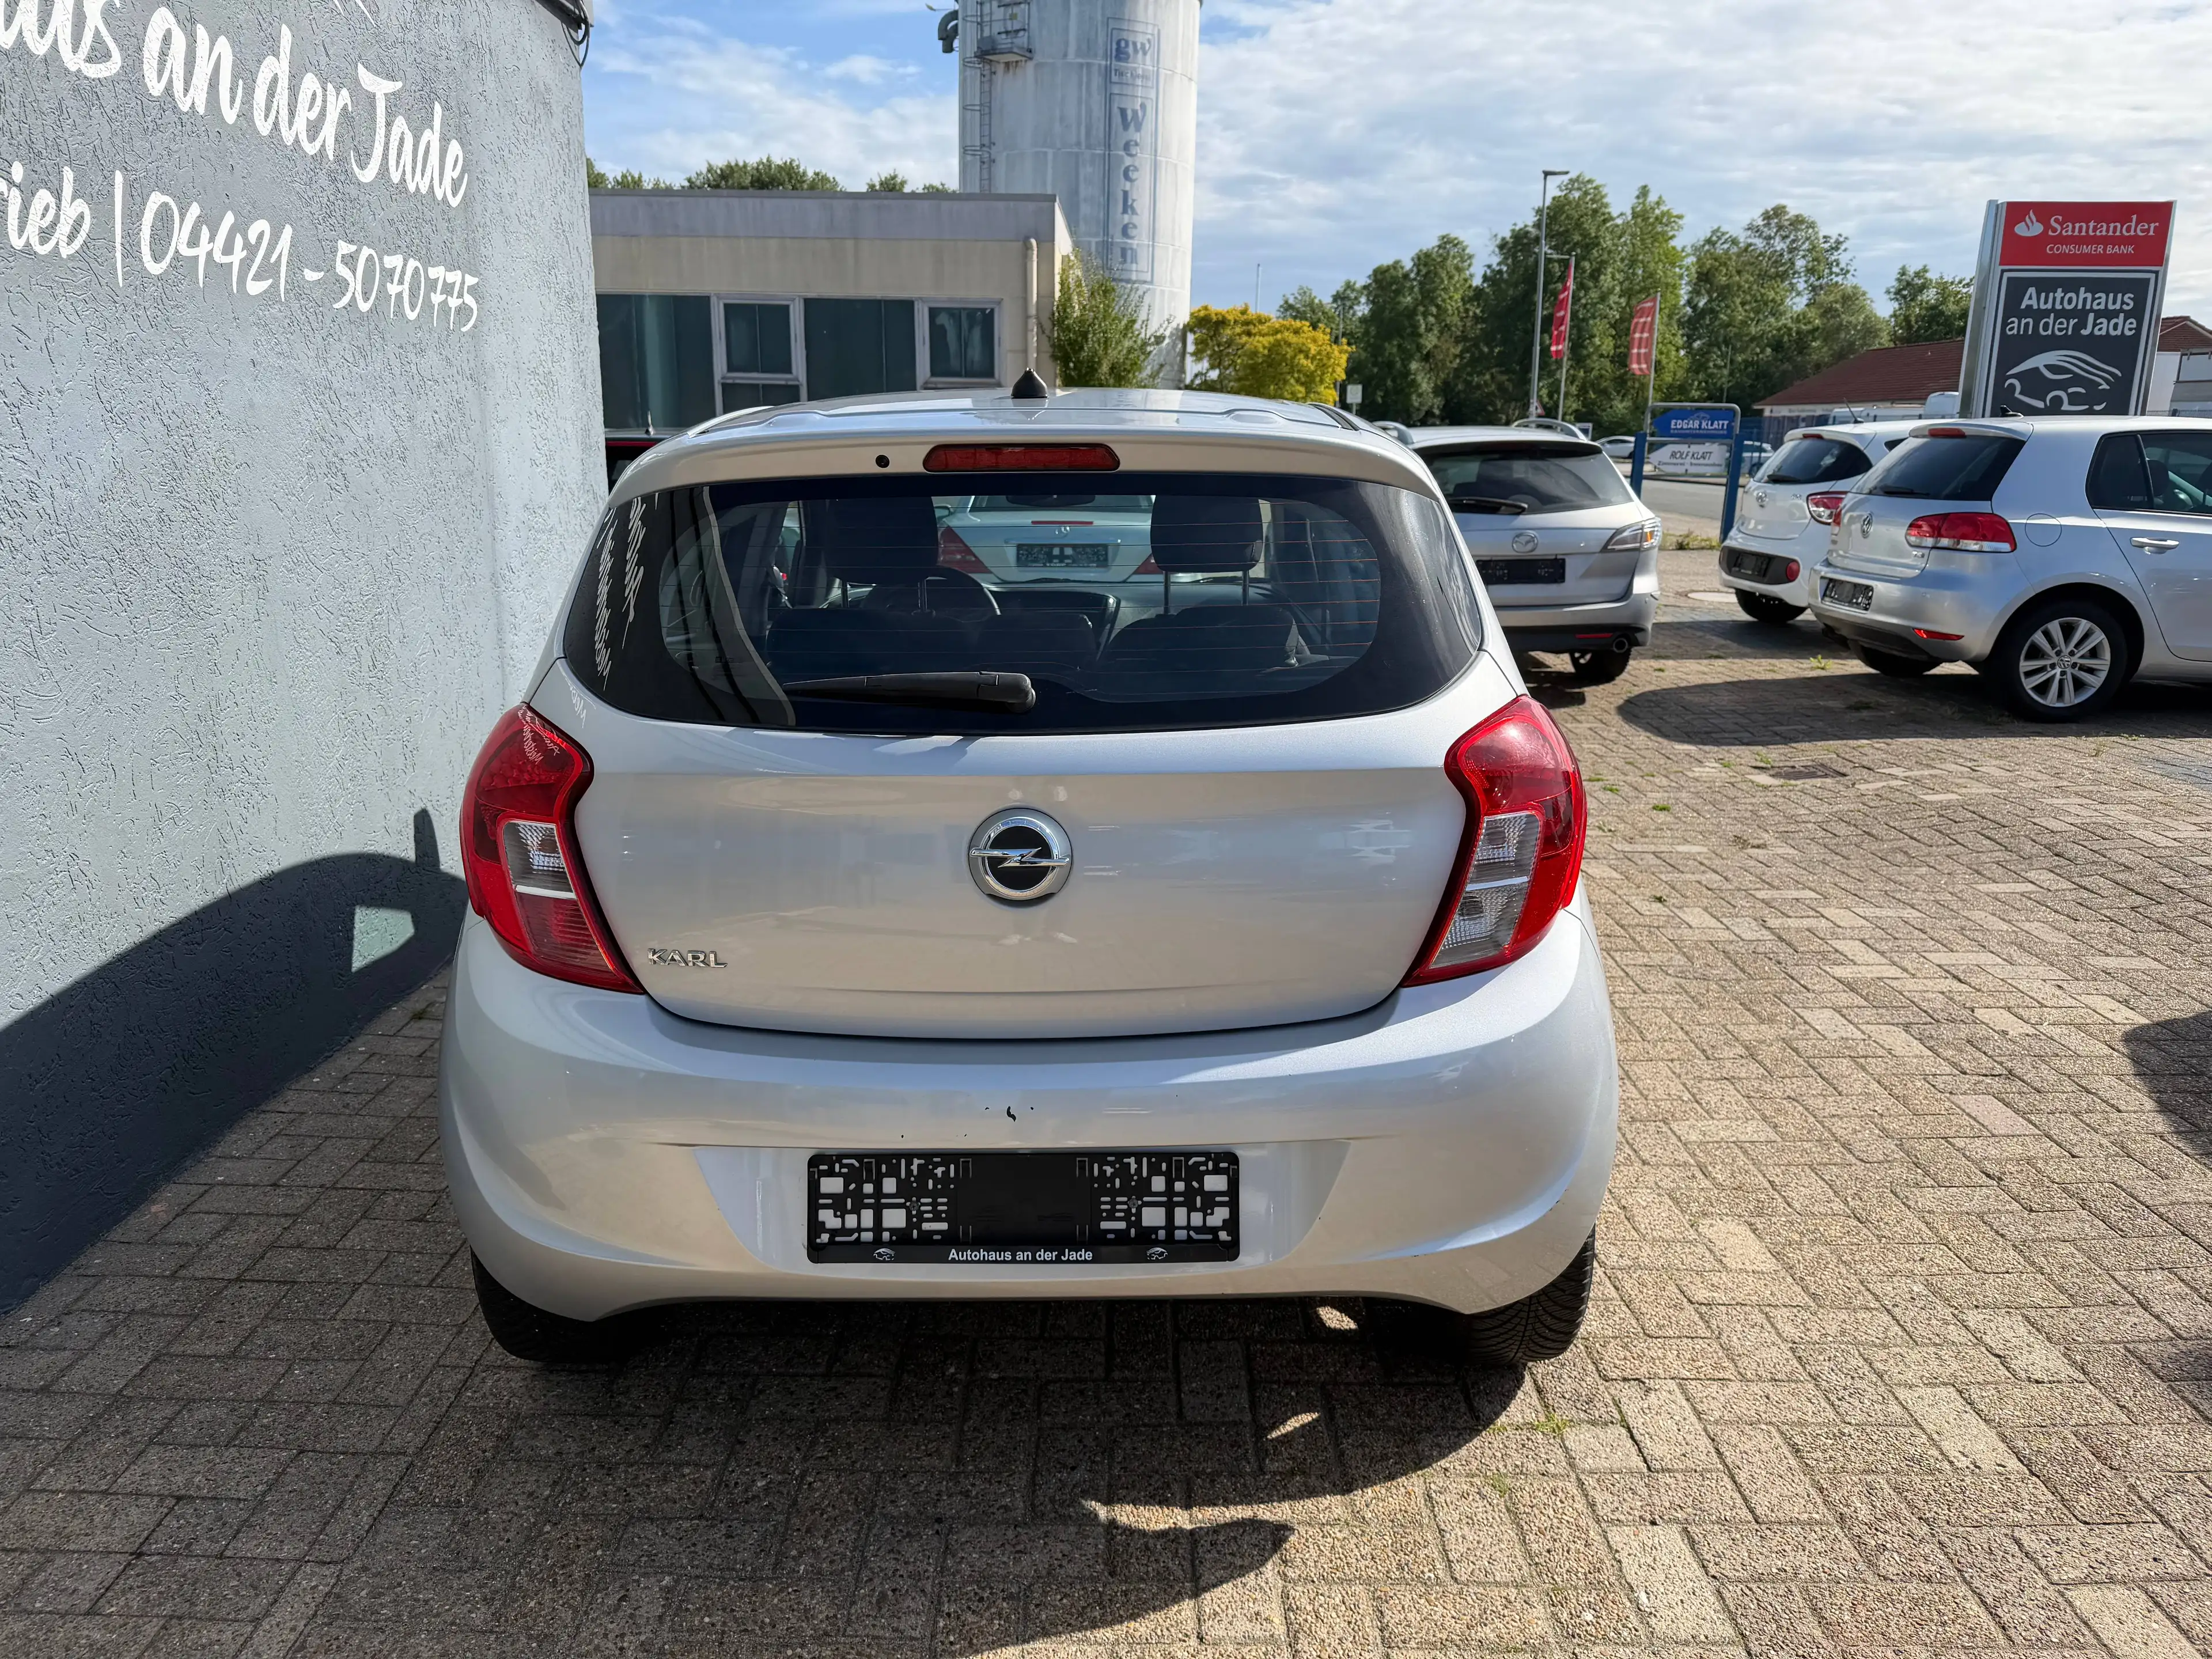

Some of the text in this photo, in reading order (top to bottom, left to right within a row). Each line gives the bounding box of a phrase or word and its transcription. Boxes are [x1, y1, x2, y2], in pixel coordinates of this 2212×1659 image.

[142, 7, 243, 124] an
[253, 24, 351, 160] der
[350, 63, 468, 207] Jade
[2048, 214, 2159, 236] Santander
[2046, 244, 2135, 254] CONSUMER BANK
[140, 191, 292, 301] 04421
[333, 240, 479, 332] 5070775
[2020, 287, 2134, 310] Autohaus
[2006, 312, 2137, 336] an der Jade
[1671, 419, 1729, 430] EDGAR KLATT
[1669, 450, 1714, 460] ROLF KLATT
[647, 948, 728, 968] KARL
[948, 1248, 1093, 1261] Autohaus an der Jade
